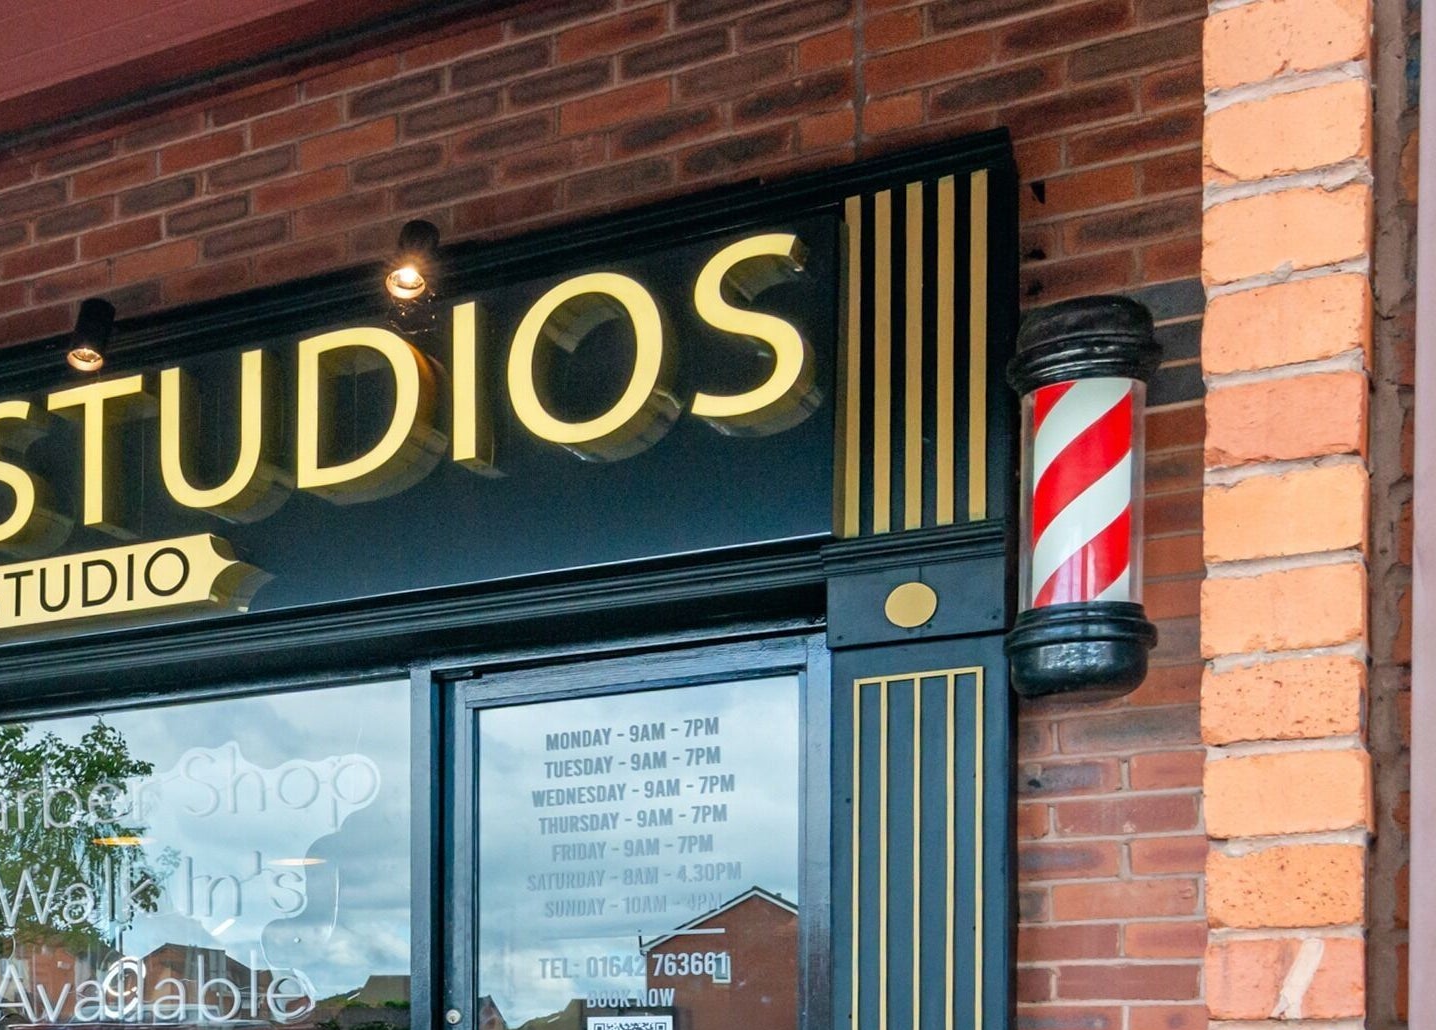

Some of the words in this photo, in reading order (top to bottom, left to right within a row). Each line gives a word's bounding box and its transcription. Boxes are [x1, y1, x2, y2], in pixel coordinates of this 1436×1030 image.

[545, 727, 612, 751] MONDAY
[629, 722, 665, 743] 9AM
[683, 716, 719, 738] 7PM
[544, 755, 613, 779] TUESDAY
[630, 750, 667, 771] 9AM
[685, 746, 721, 767] 7PM
[181, 749, 377, 830] Shop
[531, 783, 627, 808] WEDNESDAY
[644, 778, 680, 798] 9AM
[699, 773, 735, 794] 7PM
[538, 812, 619, 835] THURSDAY
[637, 807, 673, 828] 9AM
[691, 804, 728, 824] 7PM
[552, 841, 607, 863] FRIDAY
[624, 838, 660, 858] 9AM
[677, 834, 714, 854] 7PM
[527, 870, 606, 892] SATURDAY
[623, 867, 659, 886] 8AM
[677, 861, 742, 883] 4.30PM
[539, 957, 580, 979] TEL:
[587, 955, 646, 978] 01642
[587, 989, 631, 1008] BOOK
[636, 988, 675, 1008] NOW
